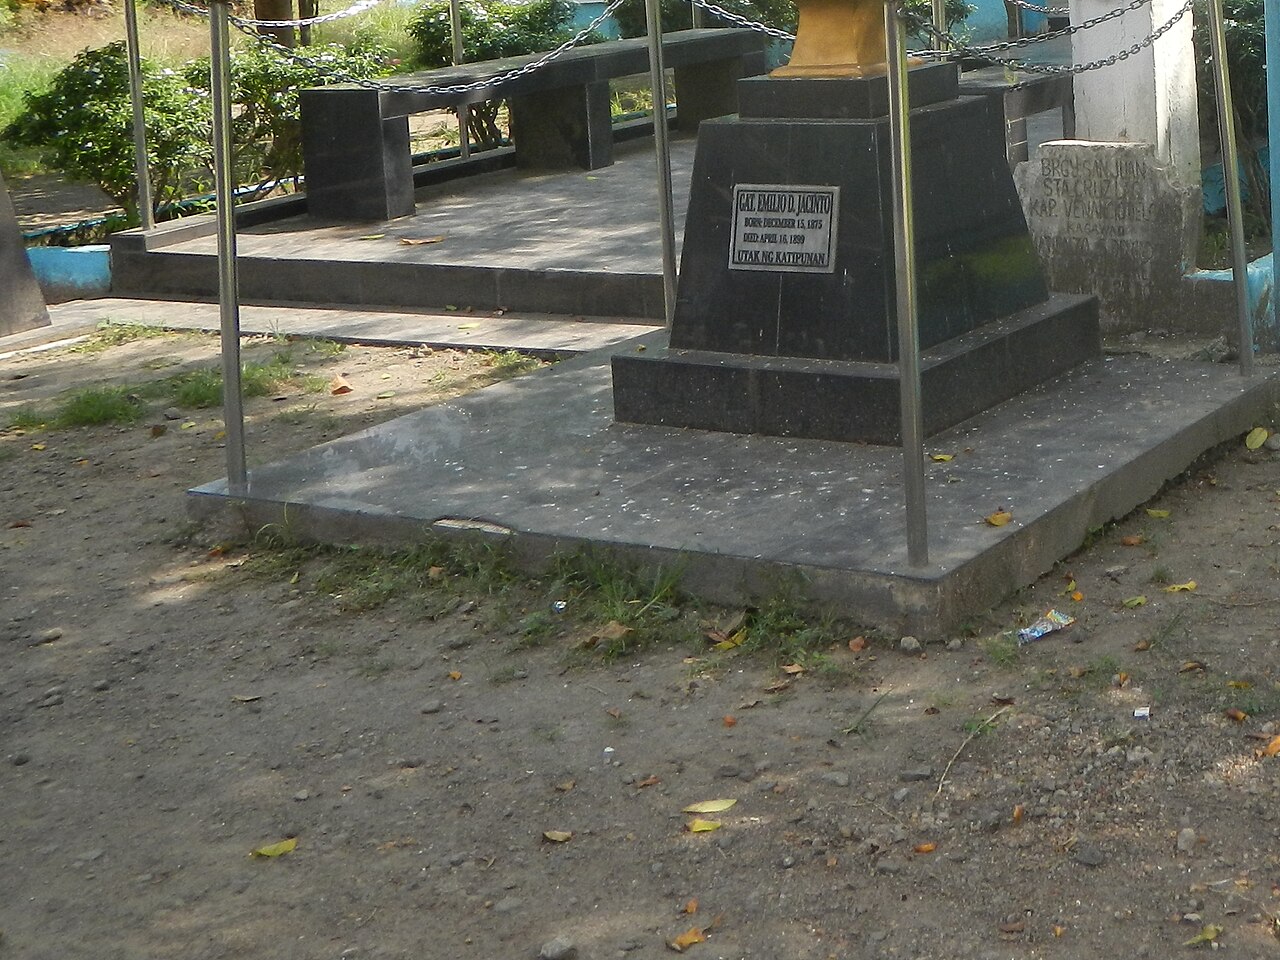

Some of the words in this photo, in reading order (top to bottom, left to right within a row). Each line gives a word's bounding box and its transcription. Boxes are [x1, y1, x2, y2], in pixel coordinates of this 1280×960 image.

[758, 194, 786, 213] EMILIO
[788, 195, 795, 212] D.
[796, 195, 830, 216] JACINTO
[807, 220, 822, 229] 1875
[738, 251, 760, 262] UTAK
[762, 252, 774, 263] NG
[776, 252, 825, 264] KATIPUNAN
